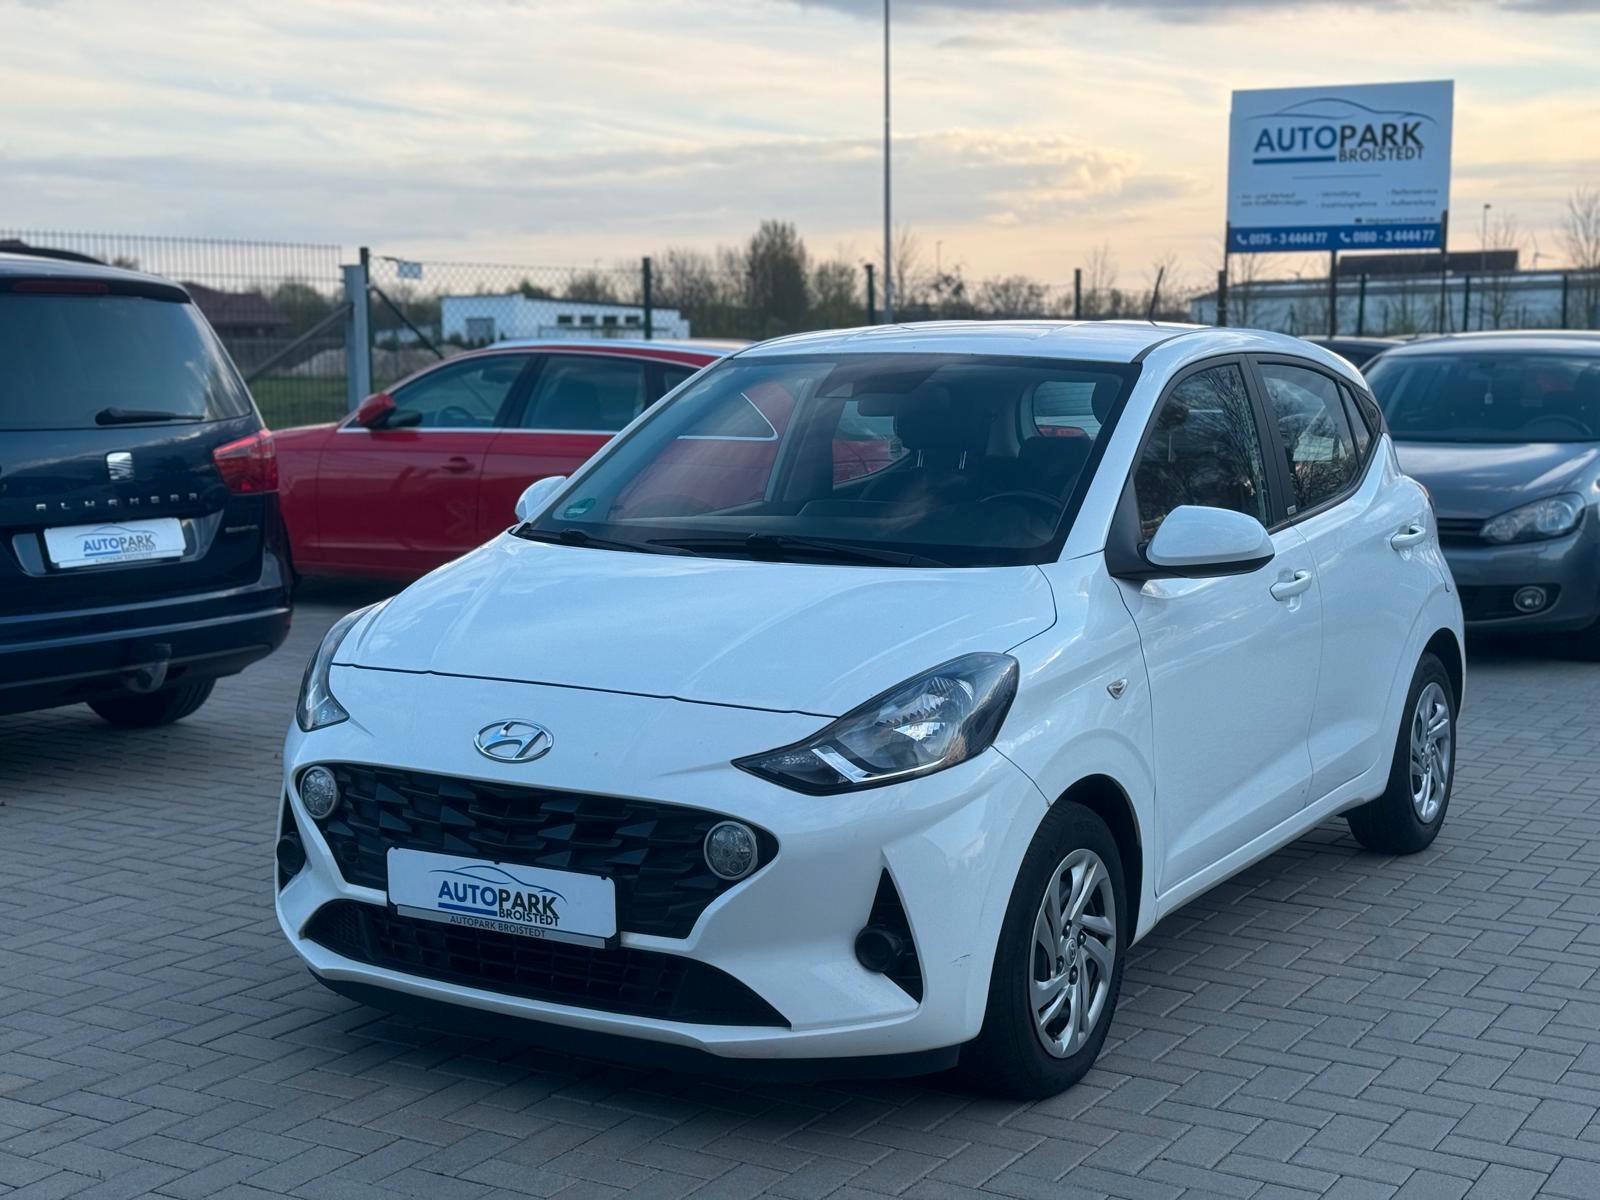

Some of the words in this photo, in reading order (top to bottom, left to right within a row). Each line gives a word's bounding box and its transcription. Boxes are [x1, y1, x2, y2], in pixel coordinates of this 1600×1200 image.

[1254, 121, 1423, 152] AUTOPARK
[1339, 146, 1424, 163] BROISTEDT
[83, 534, 155, 553] AUTOPARK
[438, 880, 558, 915] AUTOPARK
[450, 915, 496, 931] AUTOPARK
[498, 923, 546, 938] BROISTEDT
[499, 908, 561, 927] BROISTEDT
